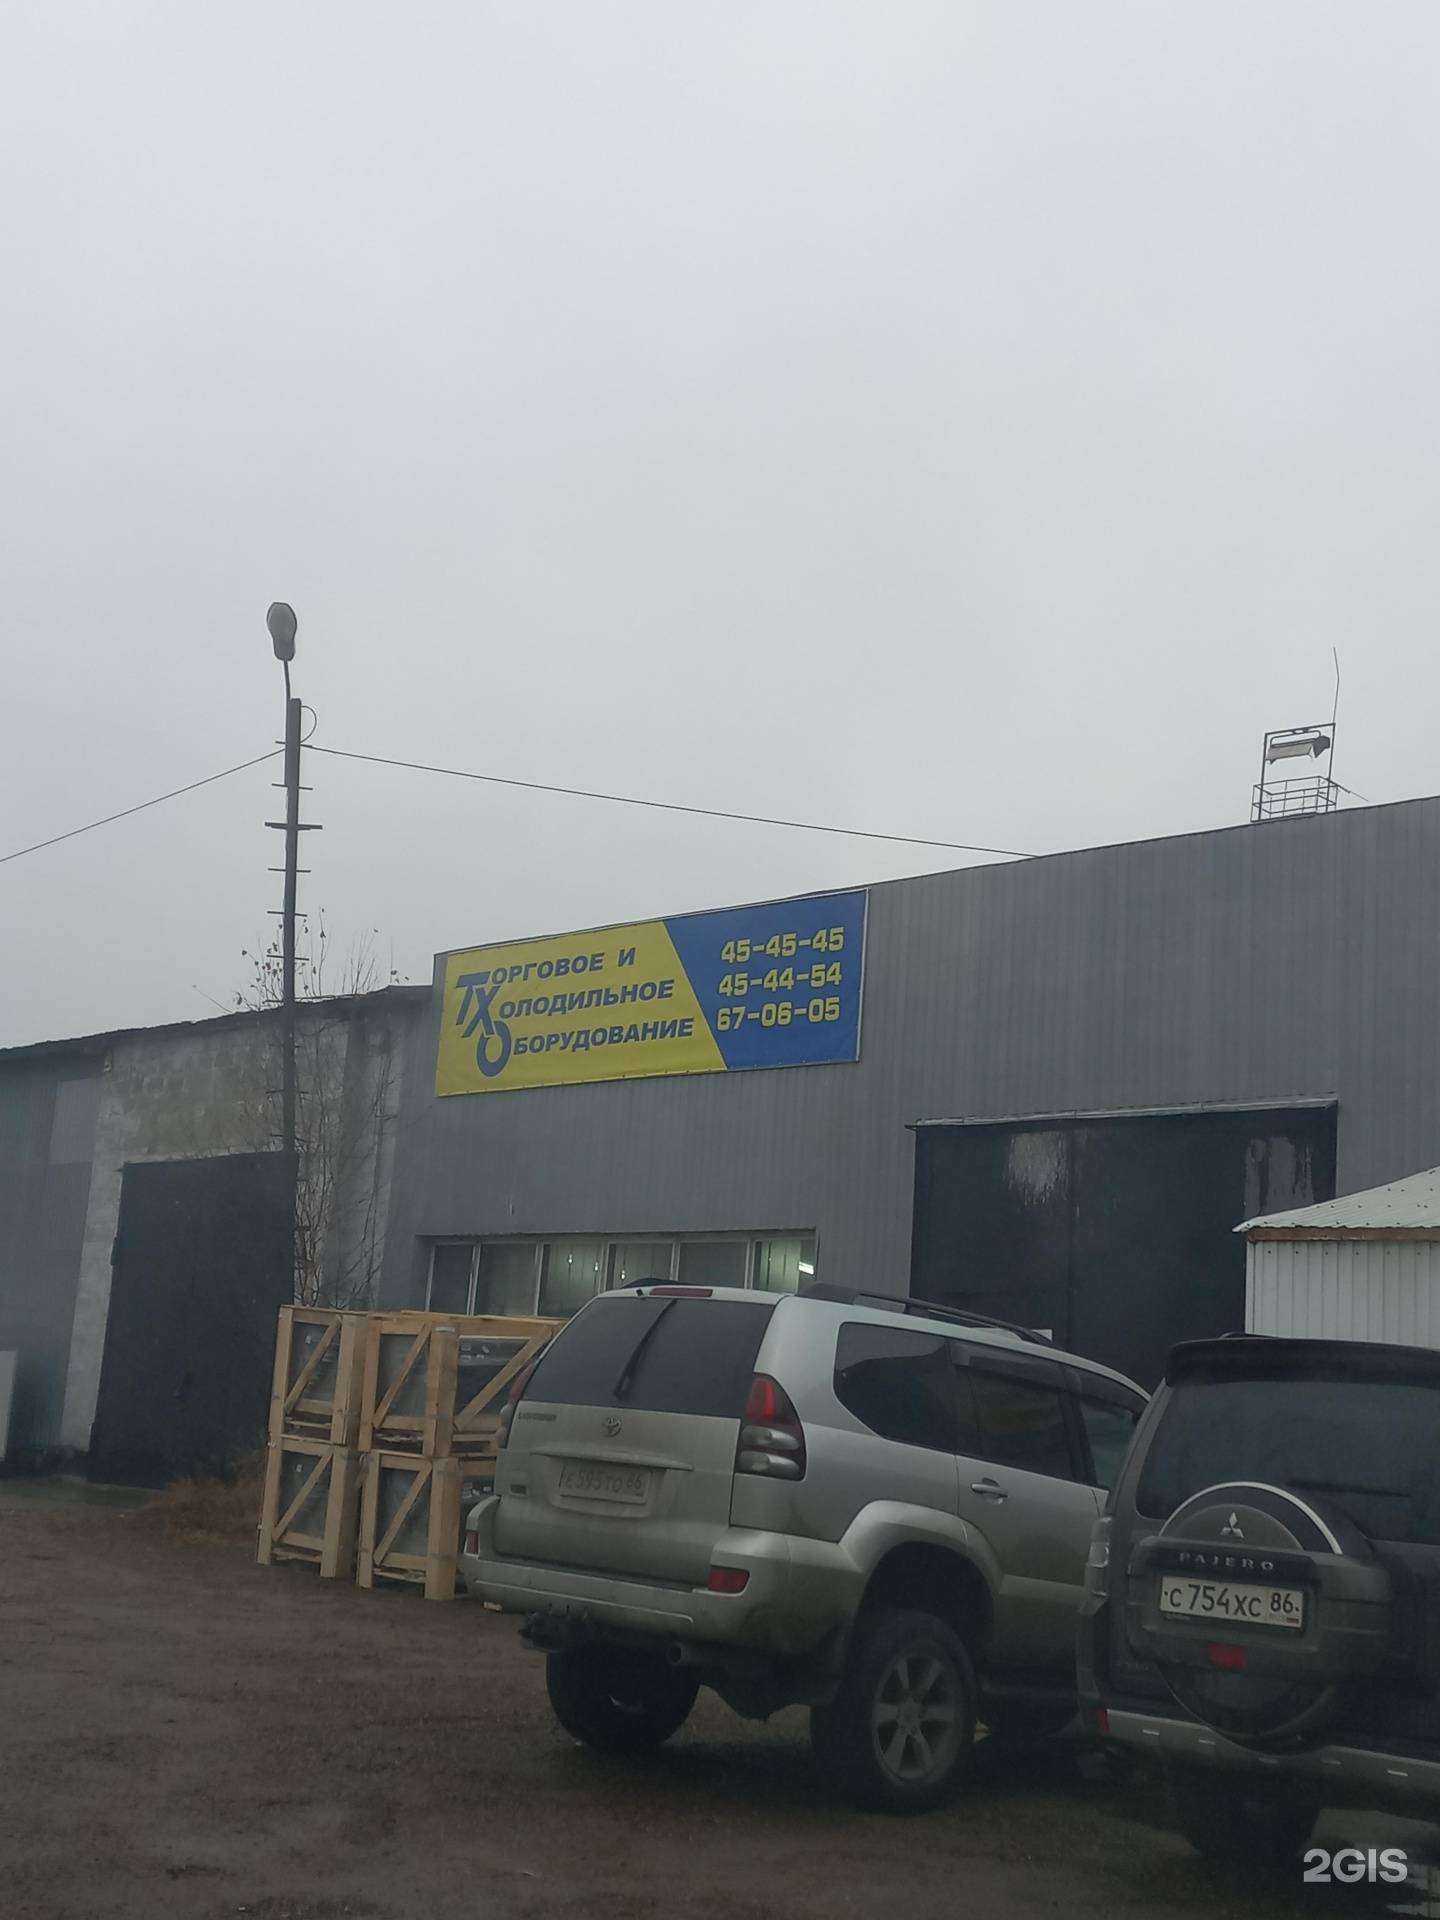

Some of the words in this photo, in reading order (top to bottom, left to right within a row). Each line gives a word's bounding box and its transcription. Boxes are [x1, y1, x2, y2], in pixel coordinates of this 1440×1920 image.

[617, 947, 637, 968] И
[720, 926, 845, 964] 45-45-45
[718, 962, 842, 997] 45-44-54
[716, 996, 840, 1032] 67-06-05
[1178, 1552, 1275, 1571] PAJERO
